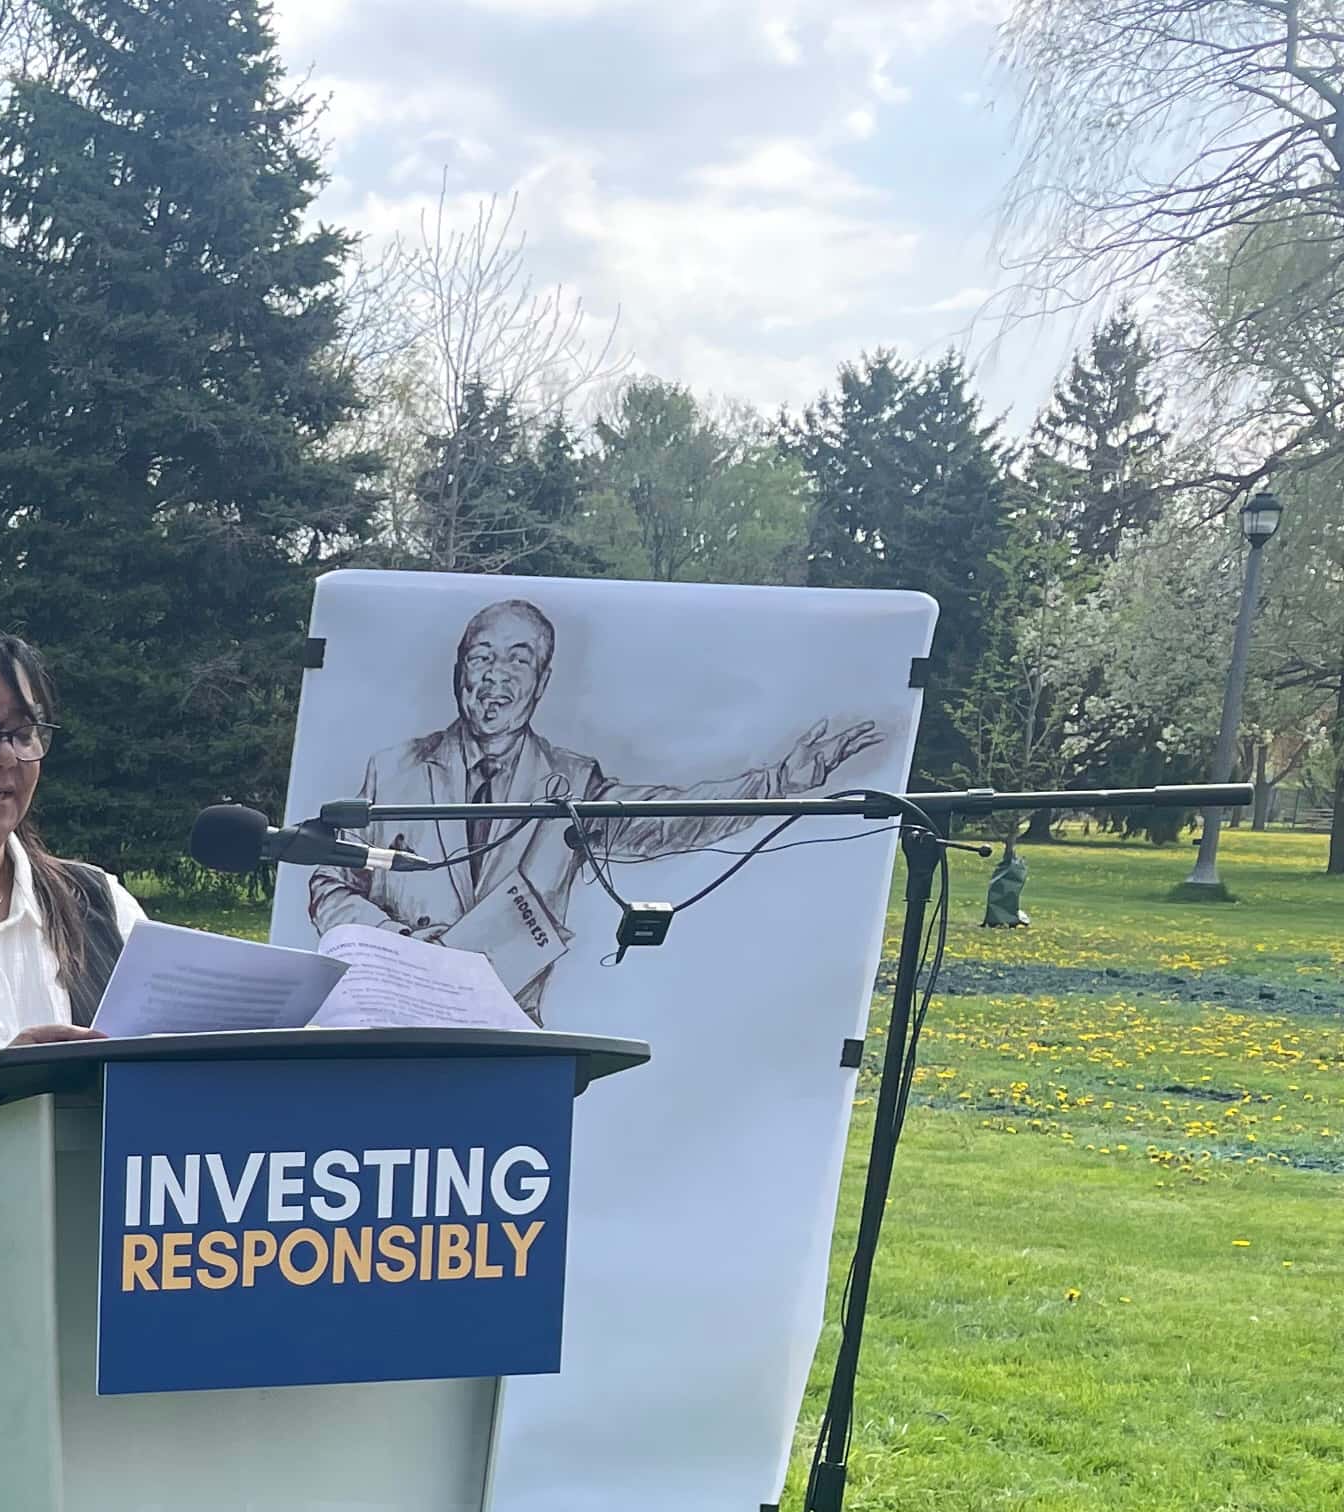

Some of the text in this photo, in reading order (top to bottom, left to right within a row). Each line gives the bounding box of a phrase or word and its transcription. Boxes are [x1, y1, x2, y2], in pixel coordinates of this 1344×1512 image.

[507, 885, 549, 948] PROGRESS
[123, 1144, 552, 1227] INVESTING
[121, 1220, 546, 1292] RESPONSIBLY
